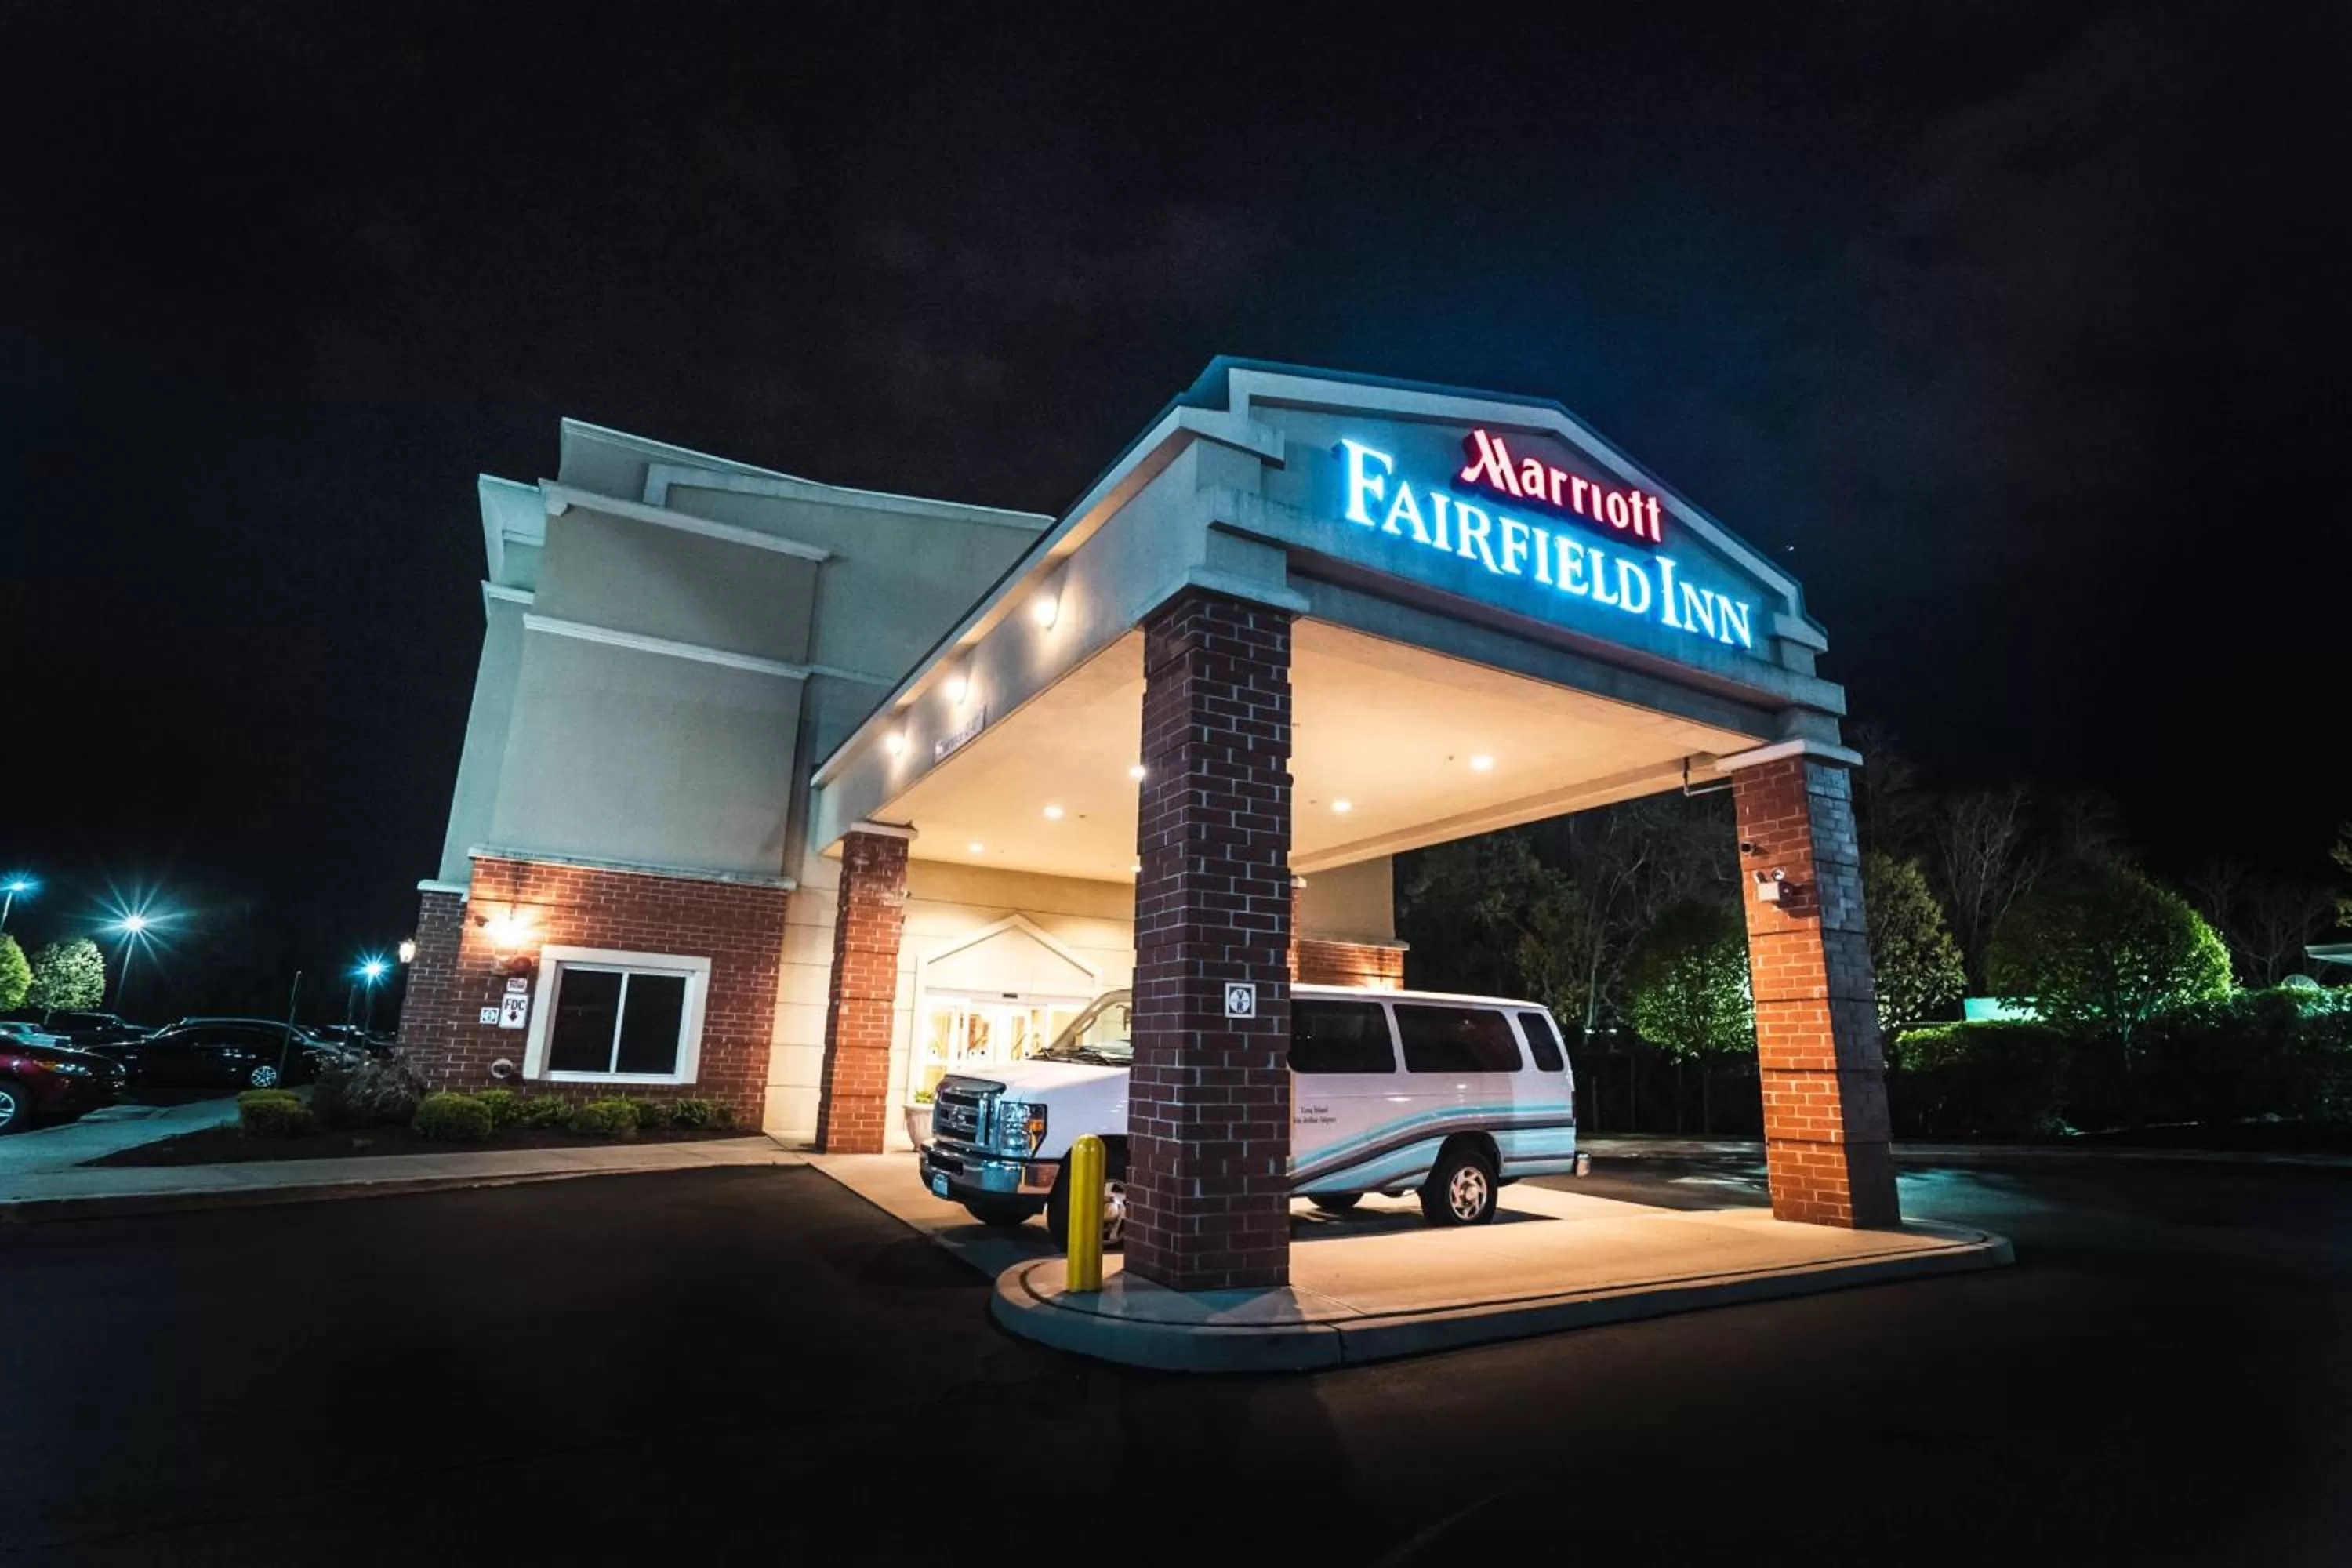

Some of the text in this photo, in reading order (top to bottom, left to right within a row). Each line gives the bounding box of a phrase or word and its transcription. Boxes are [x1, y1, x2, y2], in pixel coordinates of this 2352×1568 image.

[1460, 428, 1661, 543] Marriott
[1341, 437, 1752, 650] FAIRFIELD INN
[504, 998, 526, 1011] FDC
